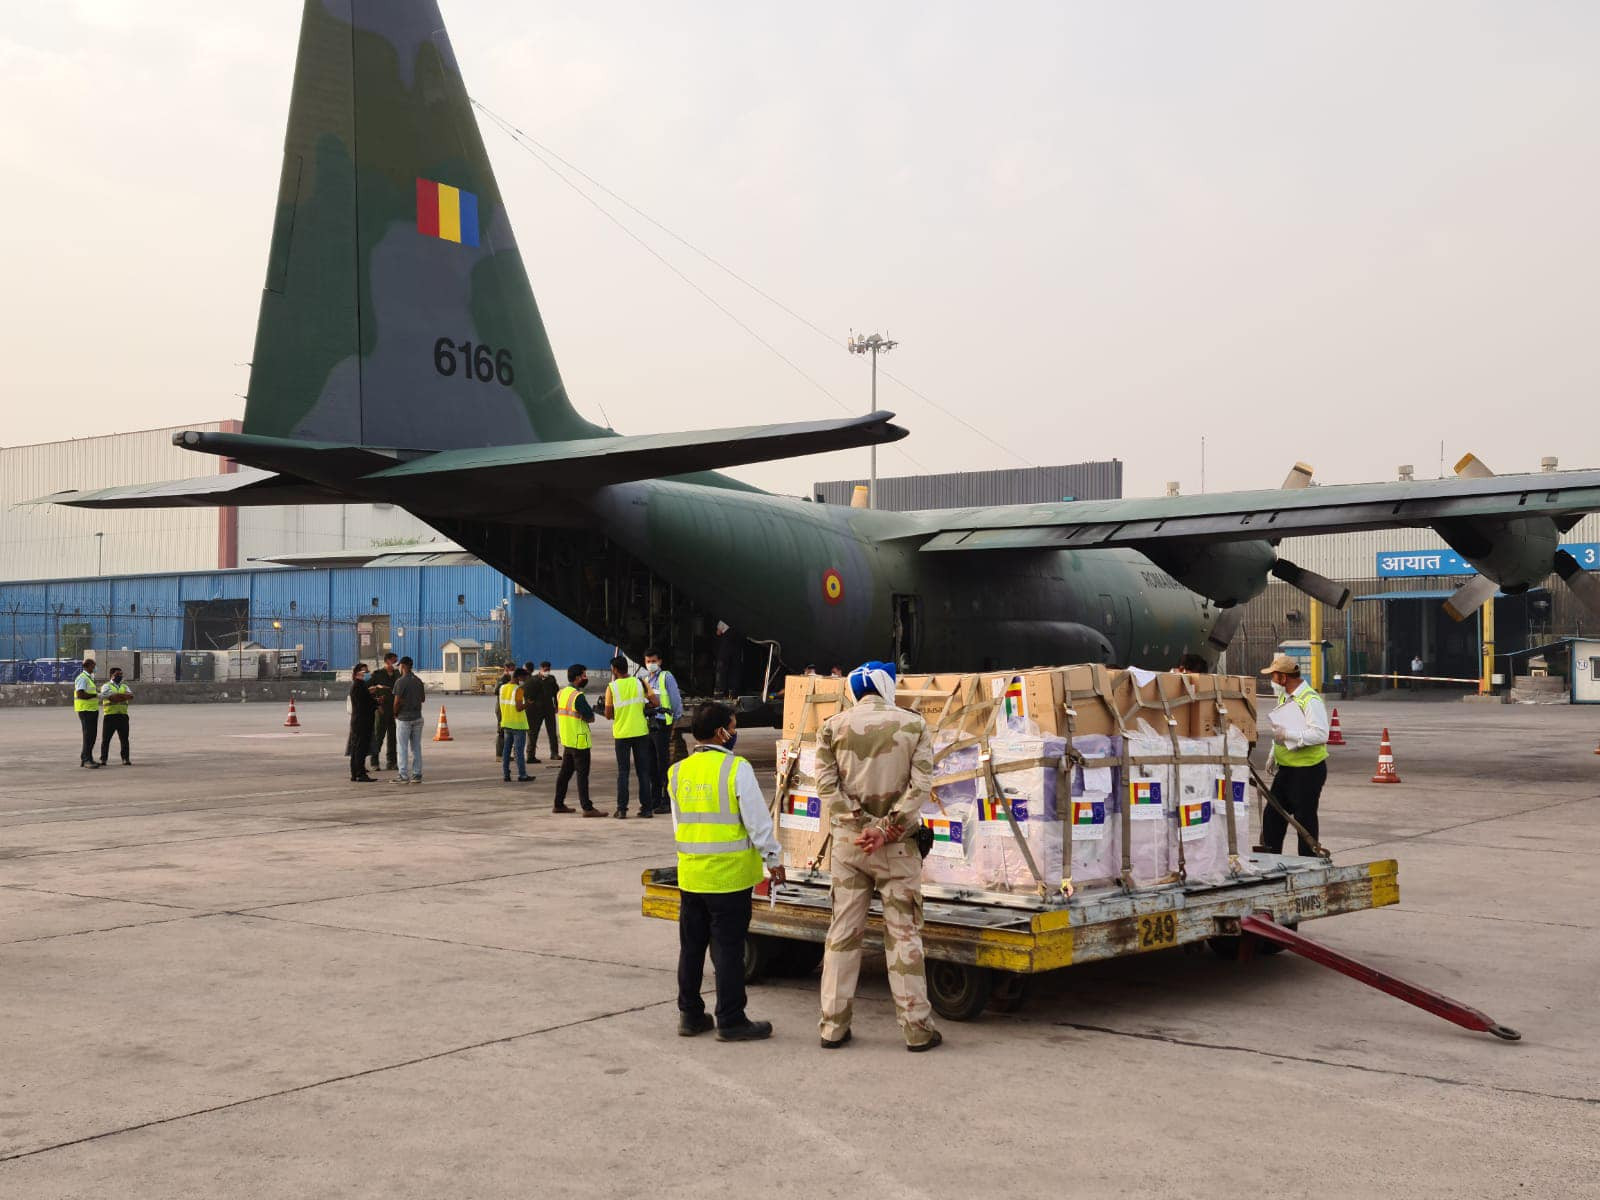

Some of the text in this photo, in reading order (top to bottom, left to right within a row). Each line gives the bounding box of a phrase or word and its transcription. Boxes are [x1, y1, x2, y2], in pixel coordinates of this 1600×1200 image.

[434, 337, 514, 386] 6166
[1381, 555, 1441, 571] आयात
[1141, 914, 1175, 948] 249
